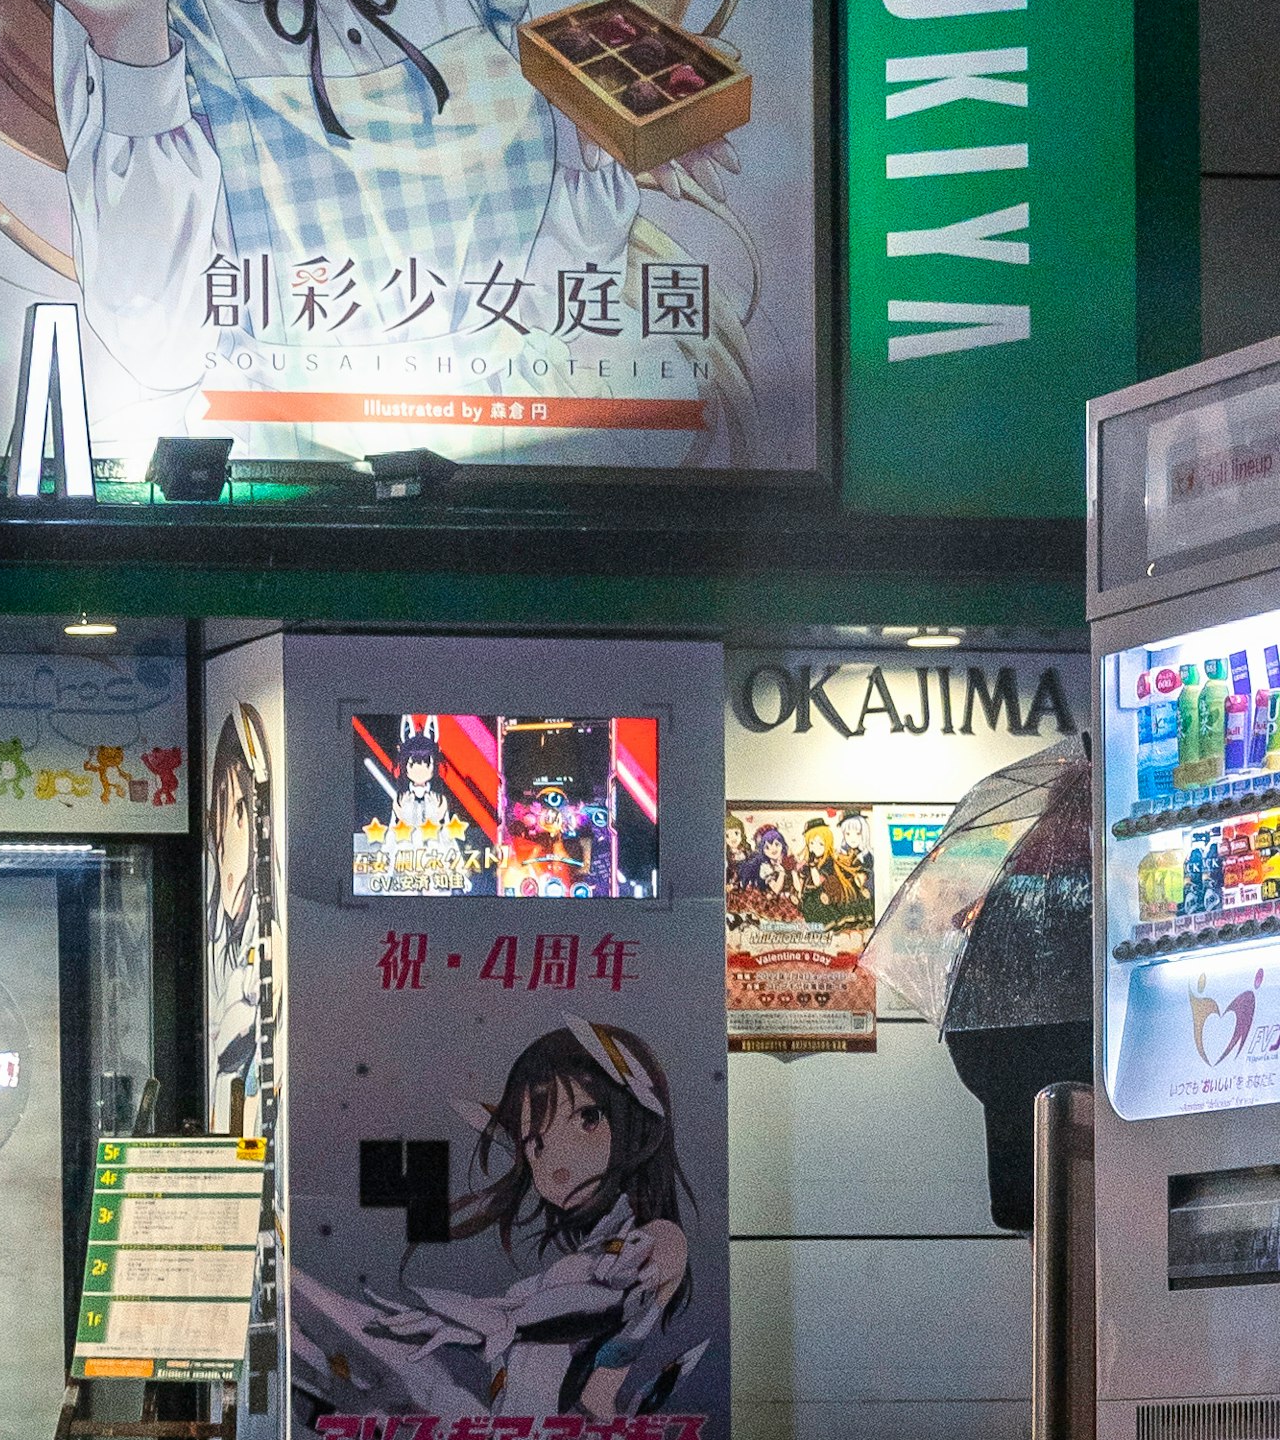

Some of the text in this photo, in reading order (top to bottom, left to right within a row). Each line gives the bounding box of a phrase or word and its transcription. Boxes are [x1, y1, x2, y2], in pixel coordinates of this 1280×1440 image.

[201, 253, 711, 339] 創彩少女庭園
[363, 399, 548, 422] Illustrated by 森倉 円
[731, 664, 1079, 739] OKAJIMA
[376, 929, 641, 992] 祝・4周年
[755, 950, 833, 967] Valentine's Day
[103, 1144, 121, 1161] 5F
[99, 1170, 118, 1186] 4F
[97, 1207, 114, 1225] 3F
[91, 1259, 109, 1277] 2F
[86, 1311, 103, 1328] 1F
